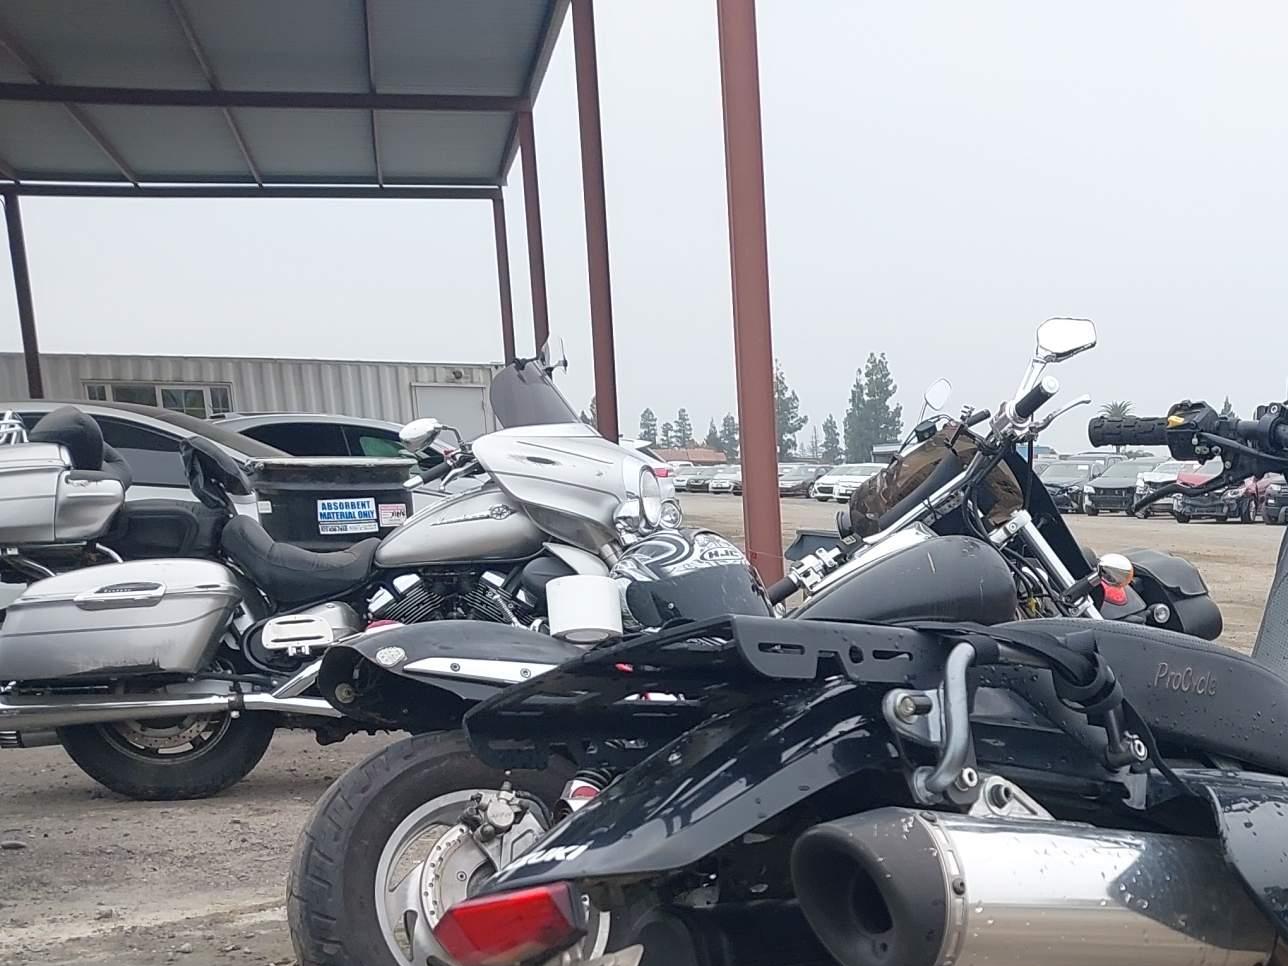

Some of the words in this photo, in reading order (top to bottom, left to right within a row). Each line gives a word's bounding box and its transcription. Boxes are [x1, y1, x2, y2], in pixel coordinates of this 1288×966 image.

[321, 501, 371, 511] ABSORBENT
[320, 511, 356, 520] MATERIAL
[357, 510, 375, 519] ONLY
